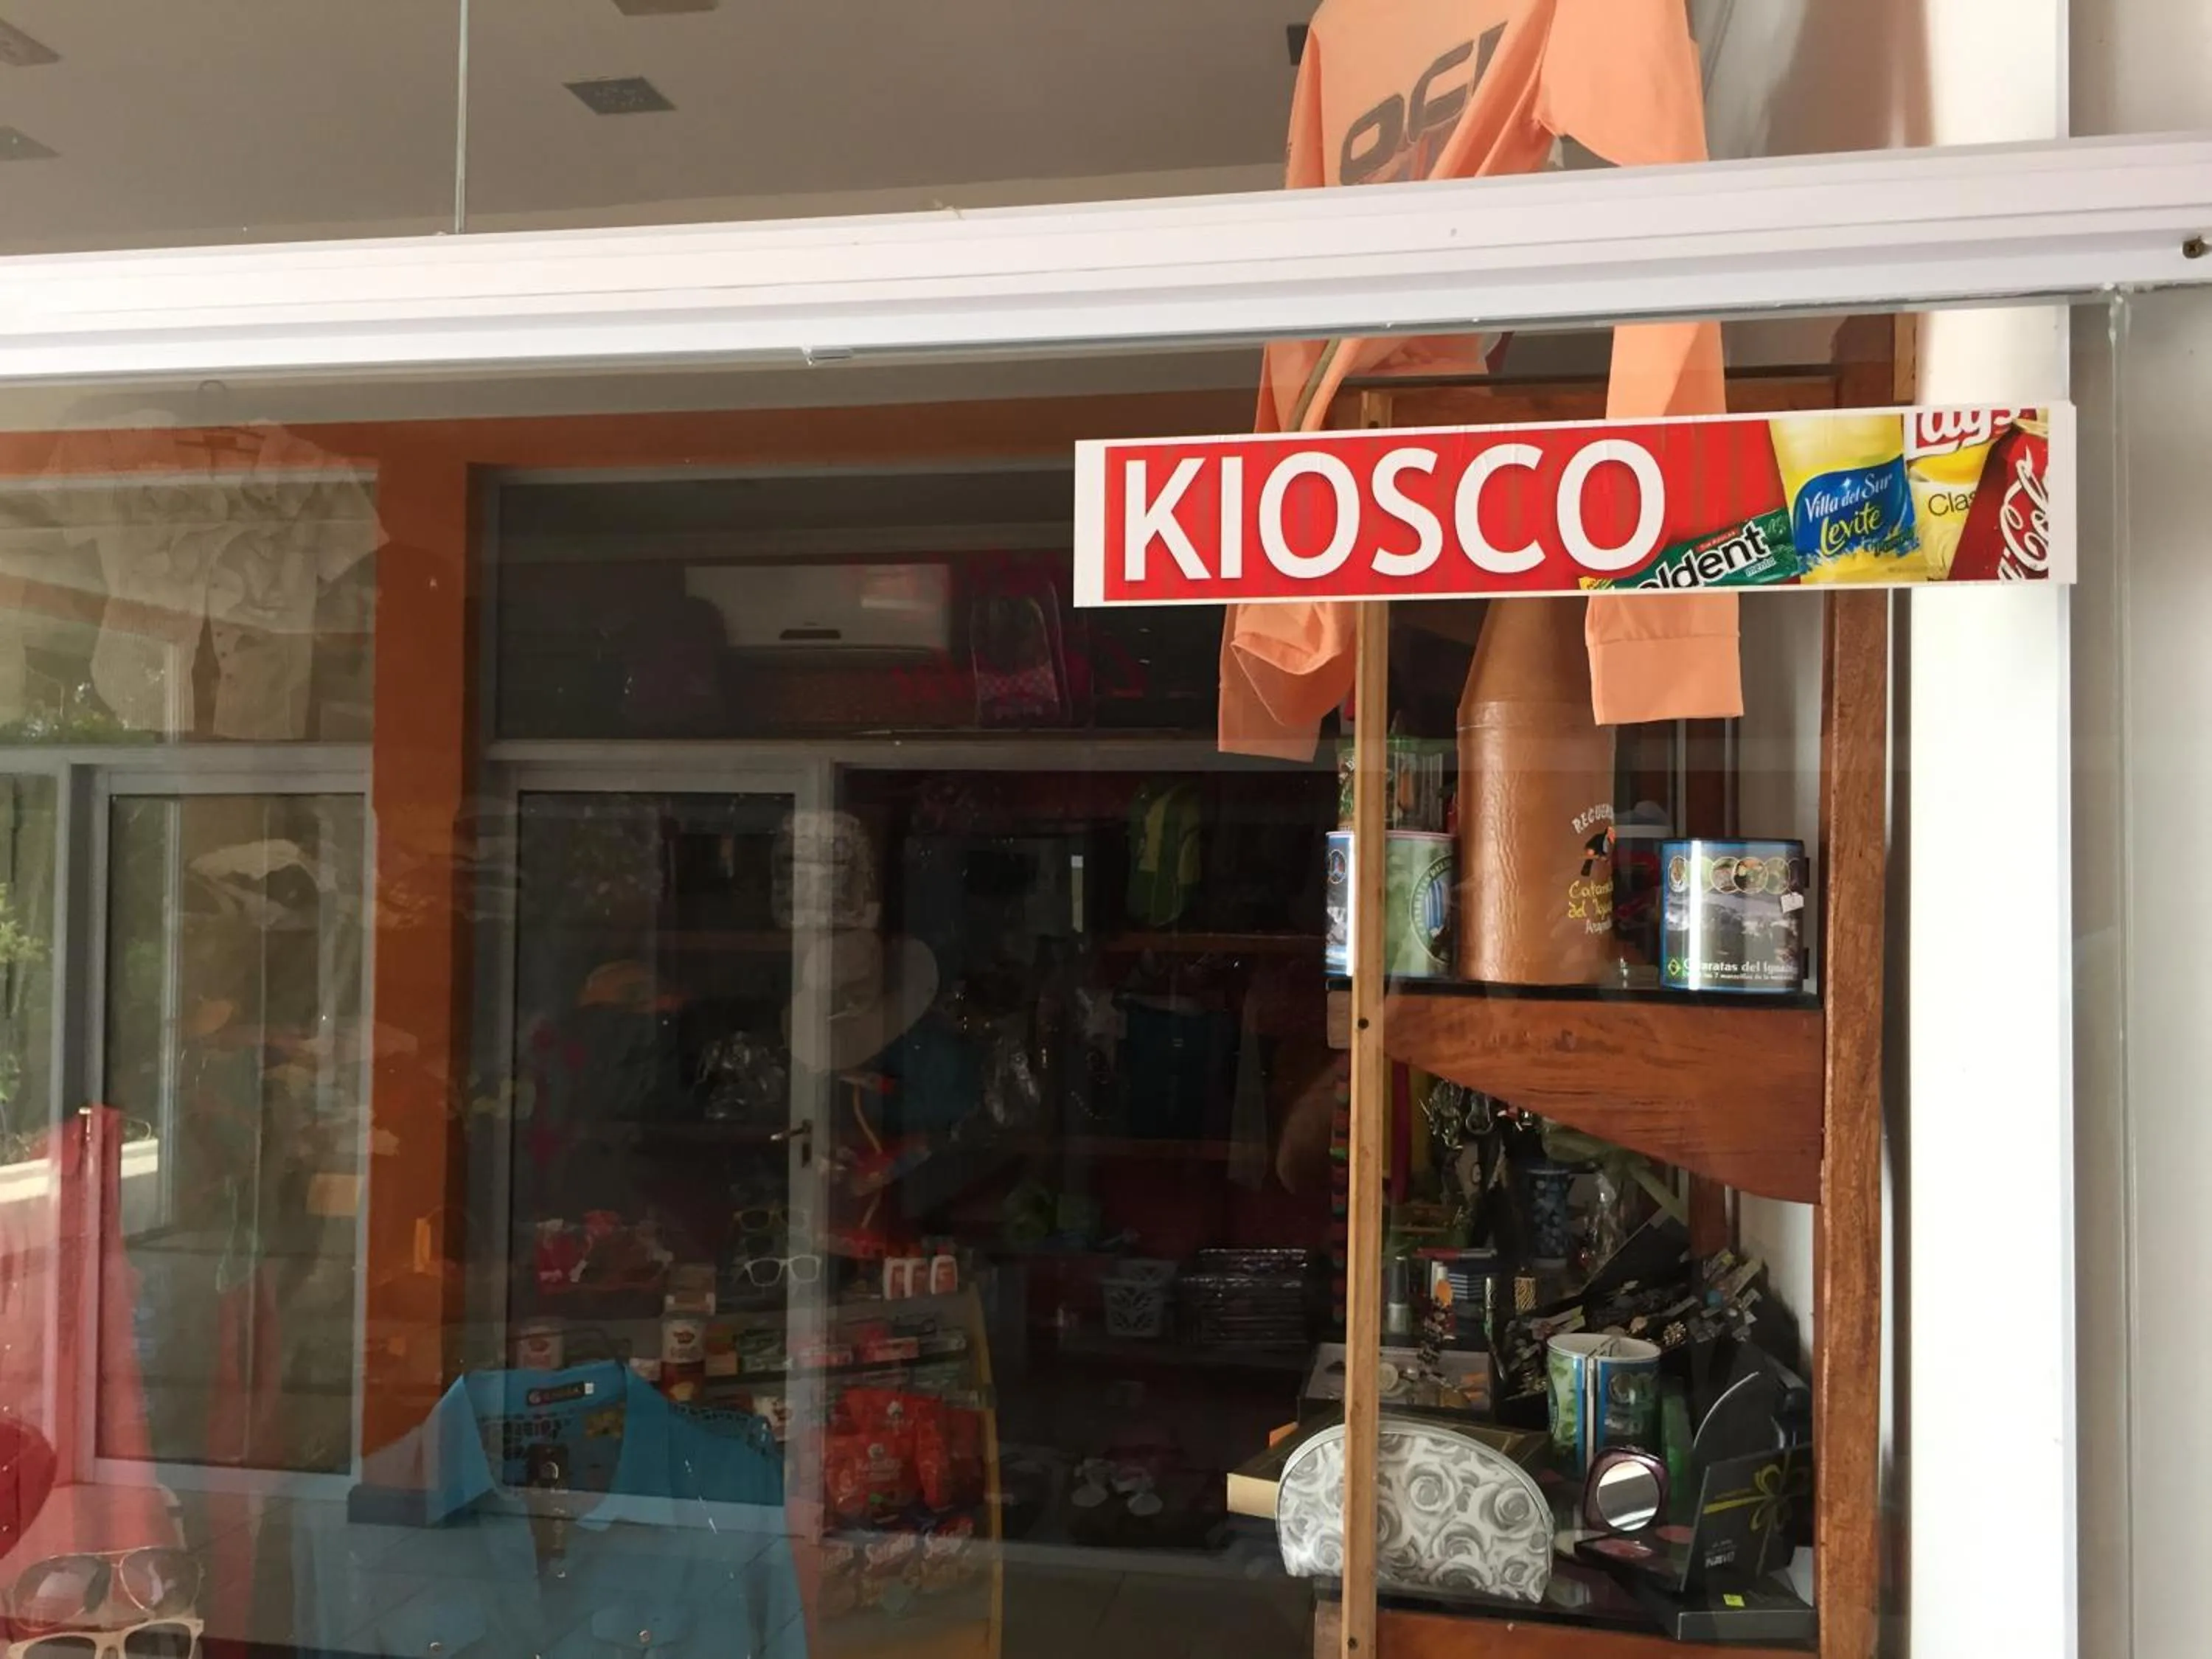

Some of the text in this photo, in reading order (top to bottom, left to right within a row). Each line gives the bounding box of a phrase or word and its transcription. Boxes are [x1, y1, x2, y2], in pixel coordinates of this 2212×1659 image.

[1125, 439, 1665, 581] KIOSCO
[1805, 473, 1893, 523] Villa del Sur
[1637, 522, 1770, 589] ldent
[1683, 960, 1739, 972] Caratas
